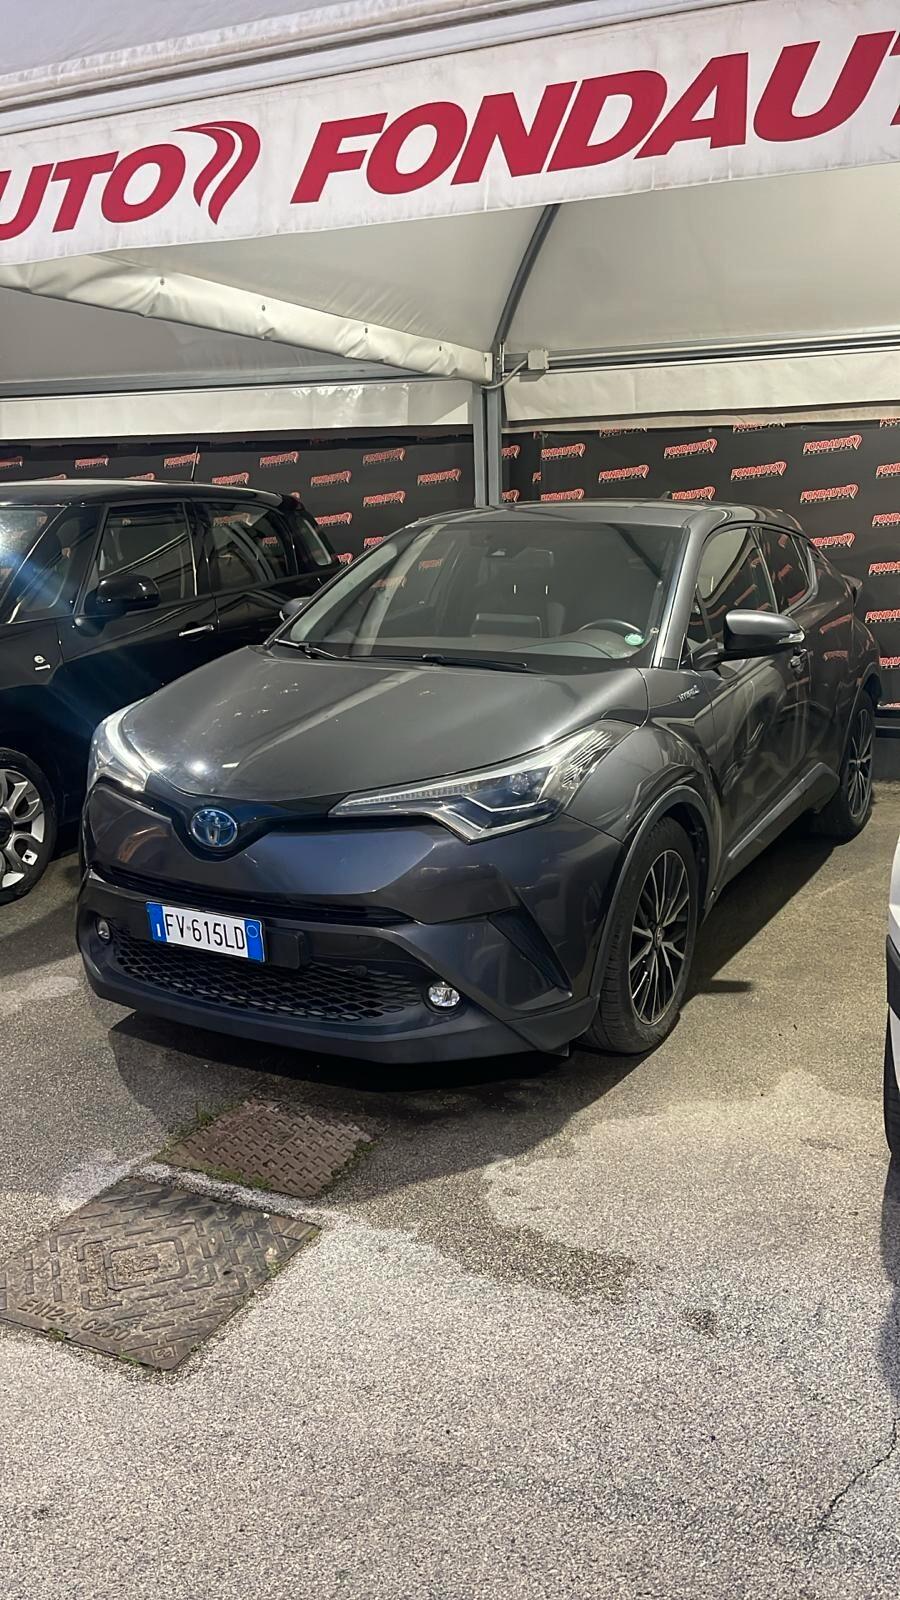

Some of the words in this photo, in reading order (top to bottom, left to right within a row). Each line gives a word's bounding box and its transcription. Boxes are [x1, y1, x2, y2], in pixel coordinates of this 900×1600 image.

[290, 30, 900, 205] FONDAU
[664, 441, 711, 459] FONDAUTO
[803, 436, 856, 455] FONDAUTO
[731, 463, 781, 481] FONDAUTO
[800, 487, 853, 503] FONDAUTO
